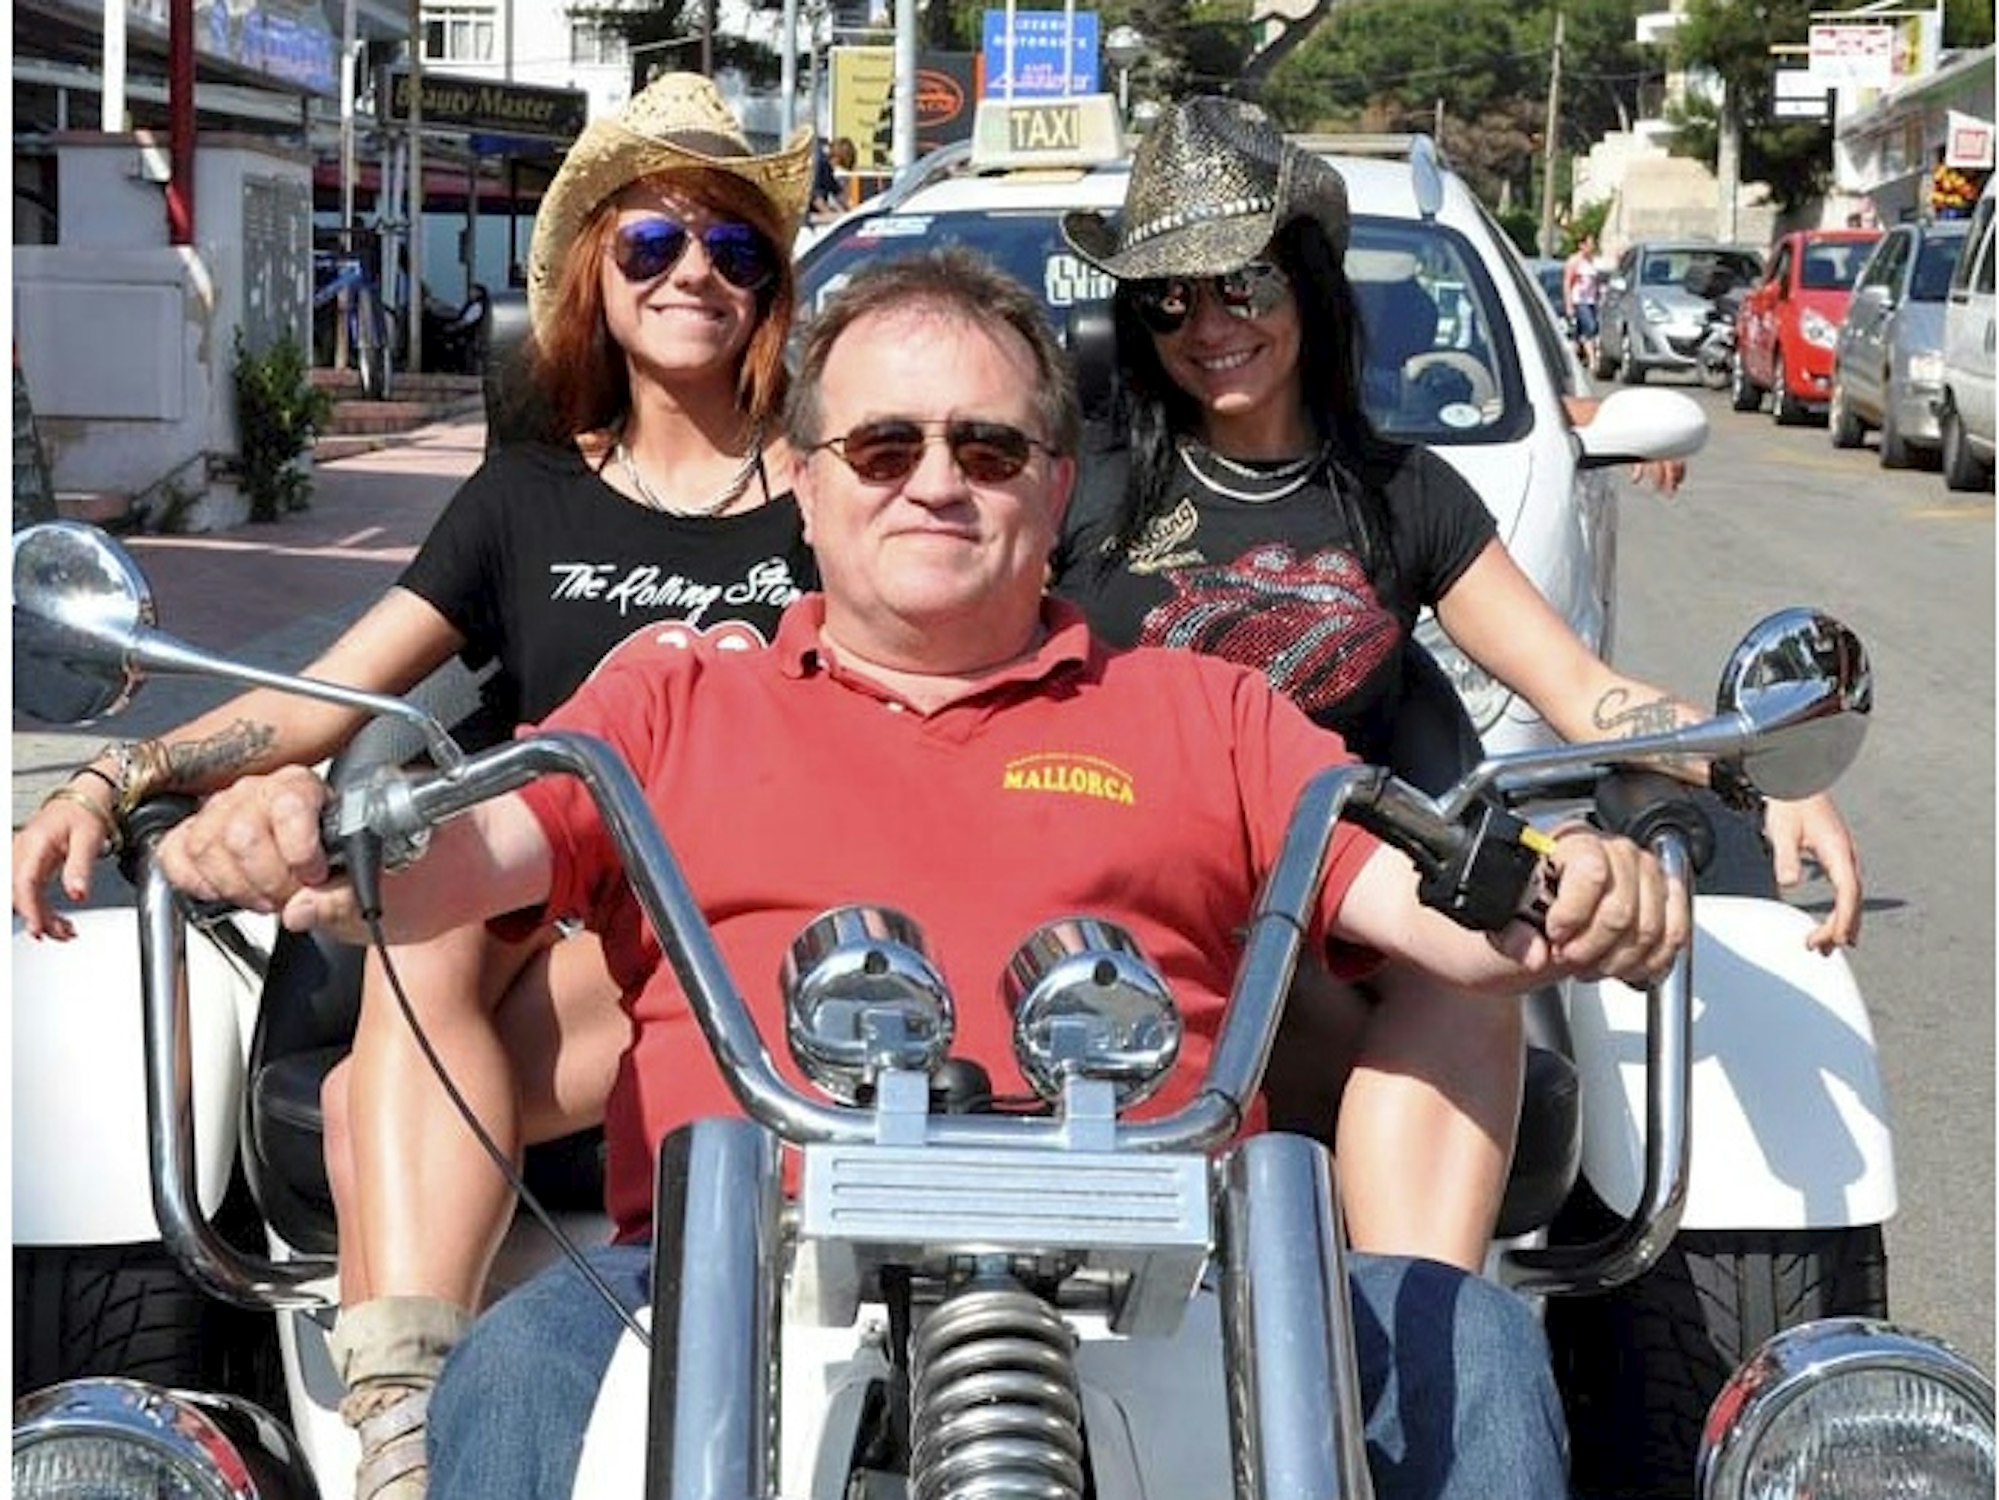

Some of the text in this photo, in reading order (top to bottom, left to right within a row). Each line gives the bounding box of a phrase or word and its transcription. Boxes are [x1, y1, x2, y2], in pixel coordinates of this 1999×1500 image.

[395, 78, 474, 114] Bauty
[1012, 108, 1079, 148] TAXI
[605, 564, 723, 627] Rolling
[1003, 765, 1135, 806] MALLORCA
